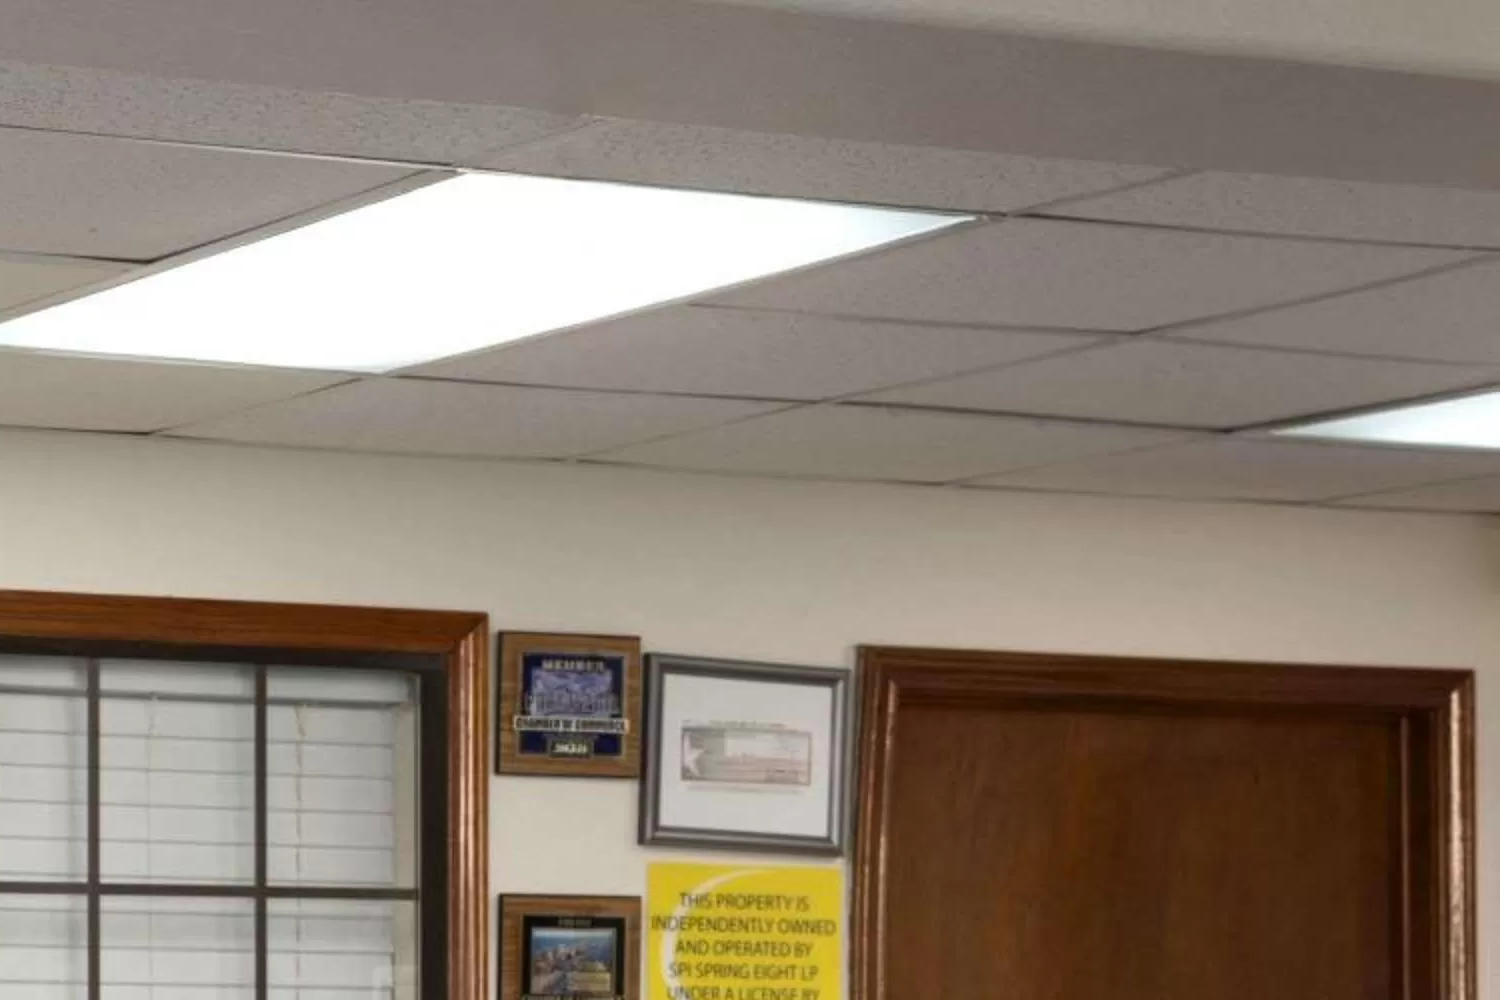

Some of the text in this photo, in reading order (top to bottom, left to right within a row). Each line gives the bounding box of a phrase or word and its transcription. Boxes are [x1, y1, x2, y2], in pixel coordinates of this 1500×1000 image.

[680, 892, 810, 911] THIS PROPERTY IS
[651, 915, 837, 936] INDEPENDENTLY OWNED
[675, 939, 814, 959] AND OPERATED BY
[668, 962, 818, 981] SPI SPRING EIGHT LP
